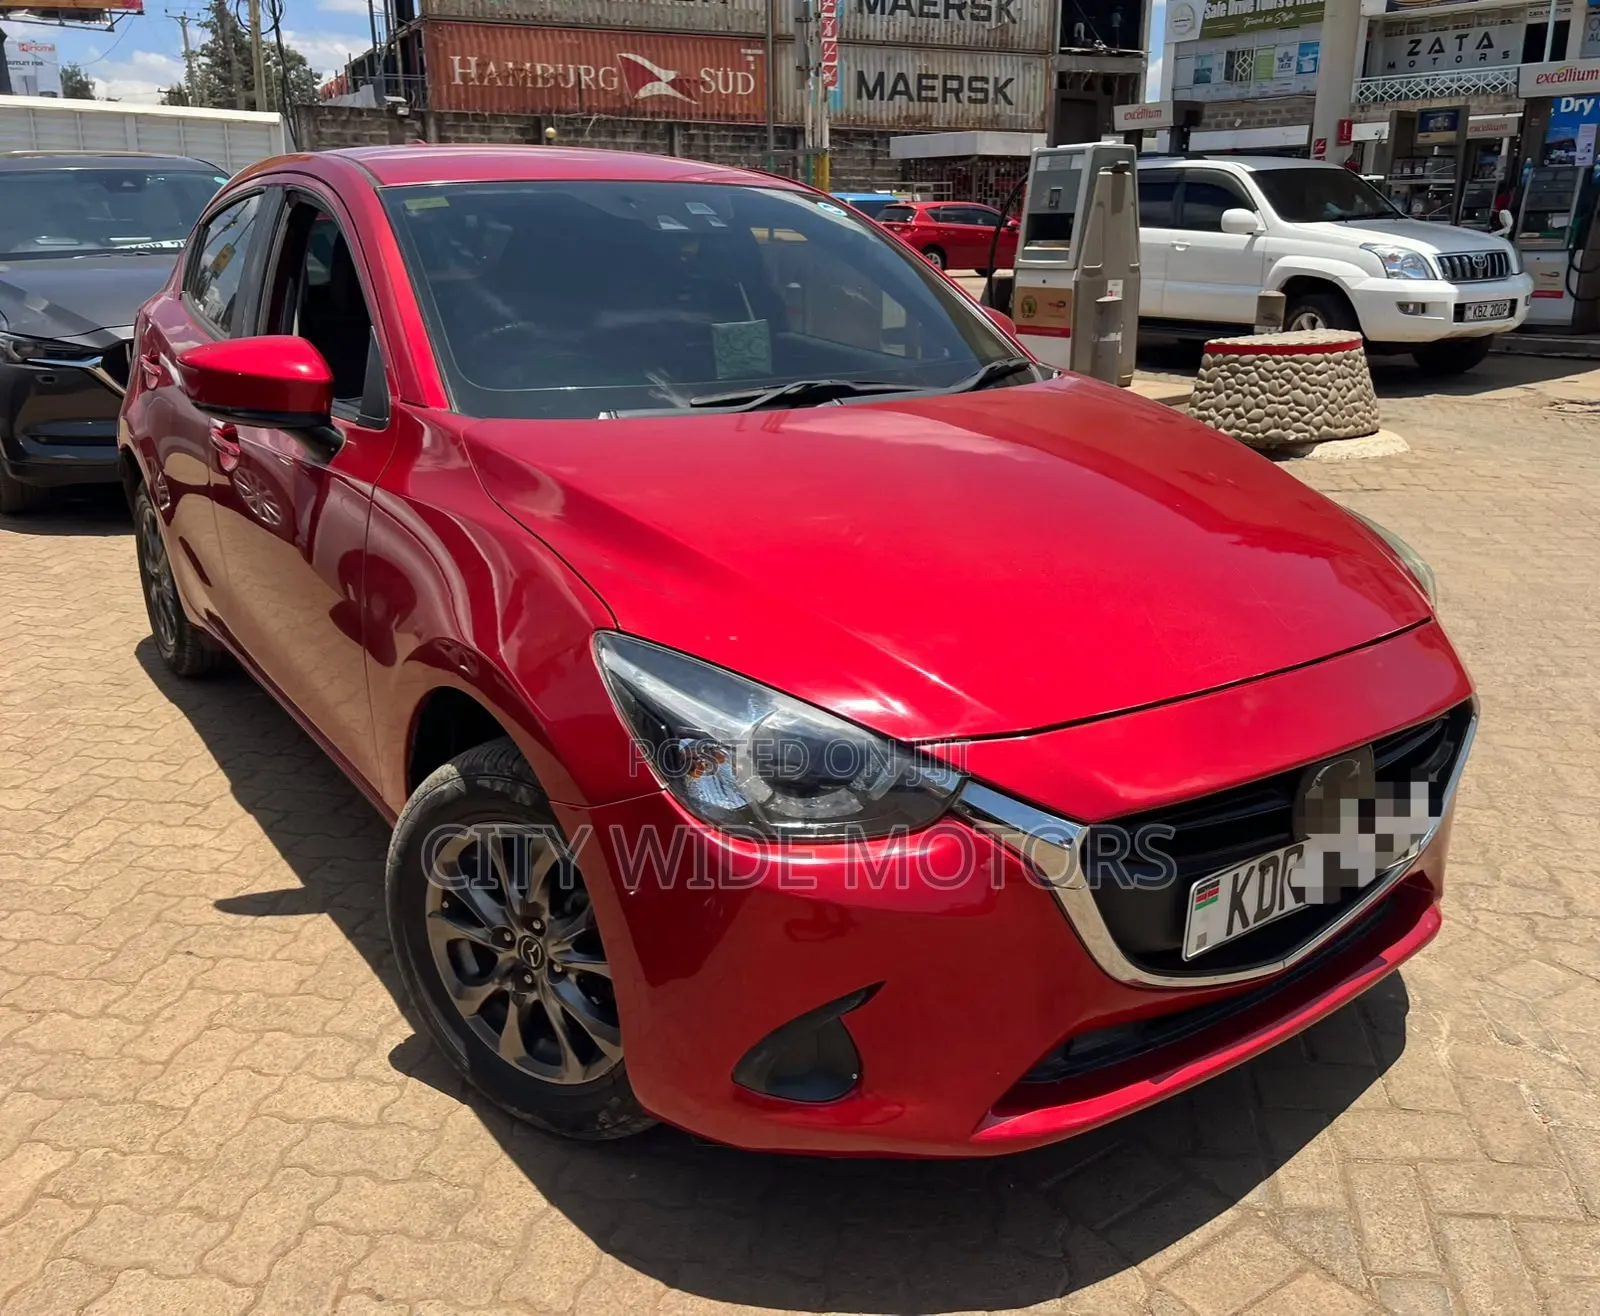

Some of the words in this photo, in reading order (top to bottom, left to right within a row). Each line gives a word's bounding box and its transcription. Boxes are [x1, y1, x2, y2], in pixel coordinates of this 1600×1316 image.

[1205, 1, 1227, 19] Safe
[1407, 31, 1494, 57] ZATA
[1387, 50, 1510, 69] MOTORS
[449, 55, 618, 91] HAMBURG
[700, 67, 755, 95] SÜD
[1536, 67, 1600, 84] excellium
[857, 70, 1015, 106] MAERSK
[1560, 97, 1595, 116] Dry
[1472, 305, 1488, 318] KBZ
